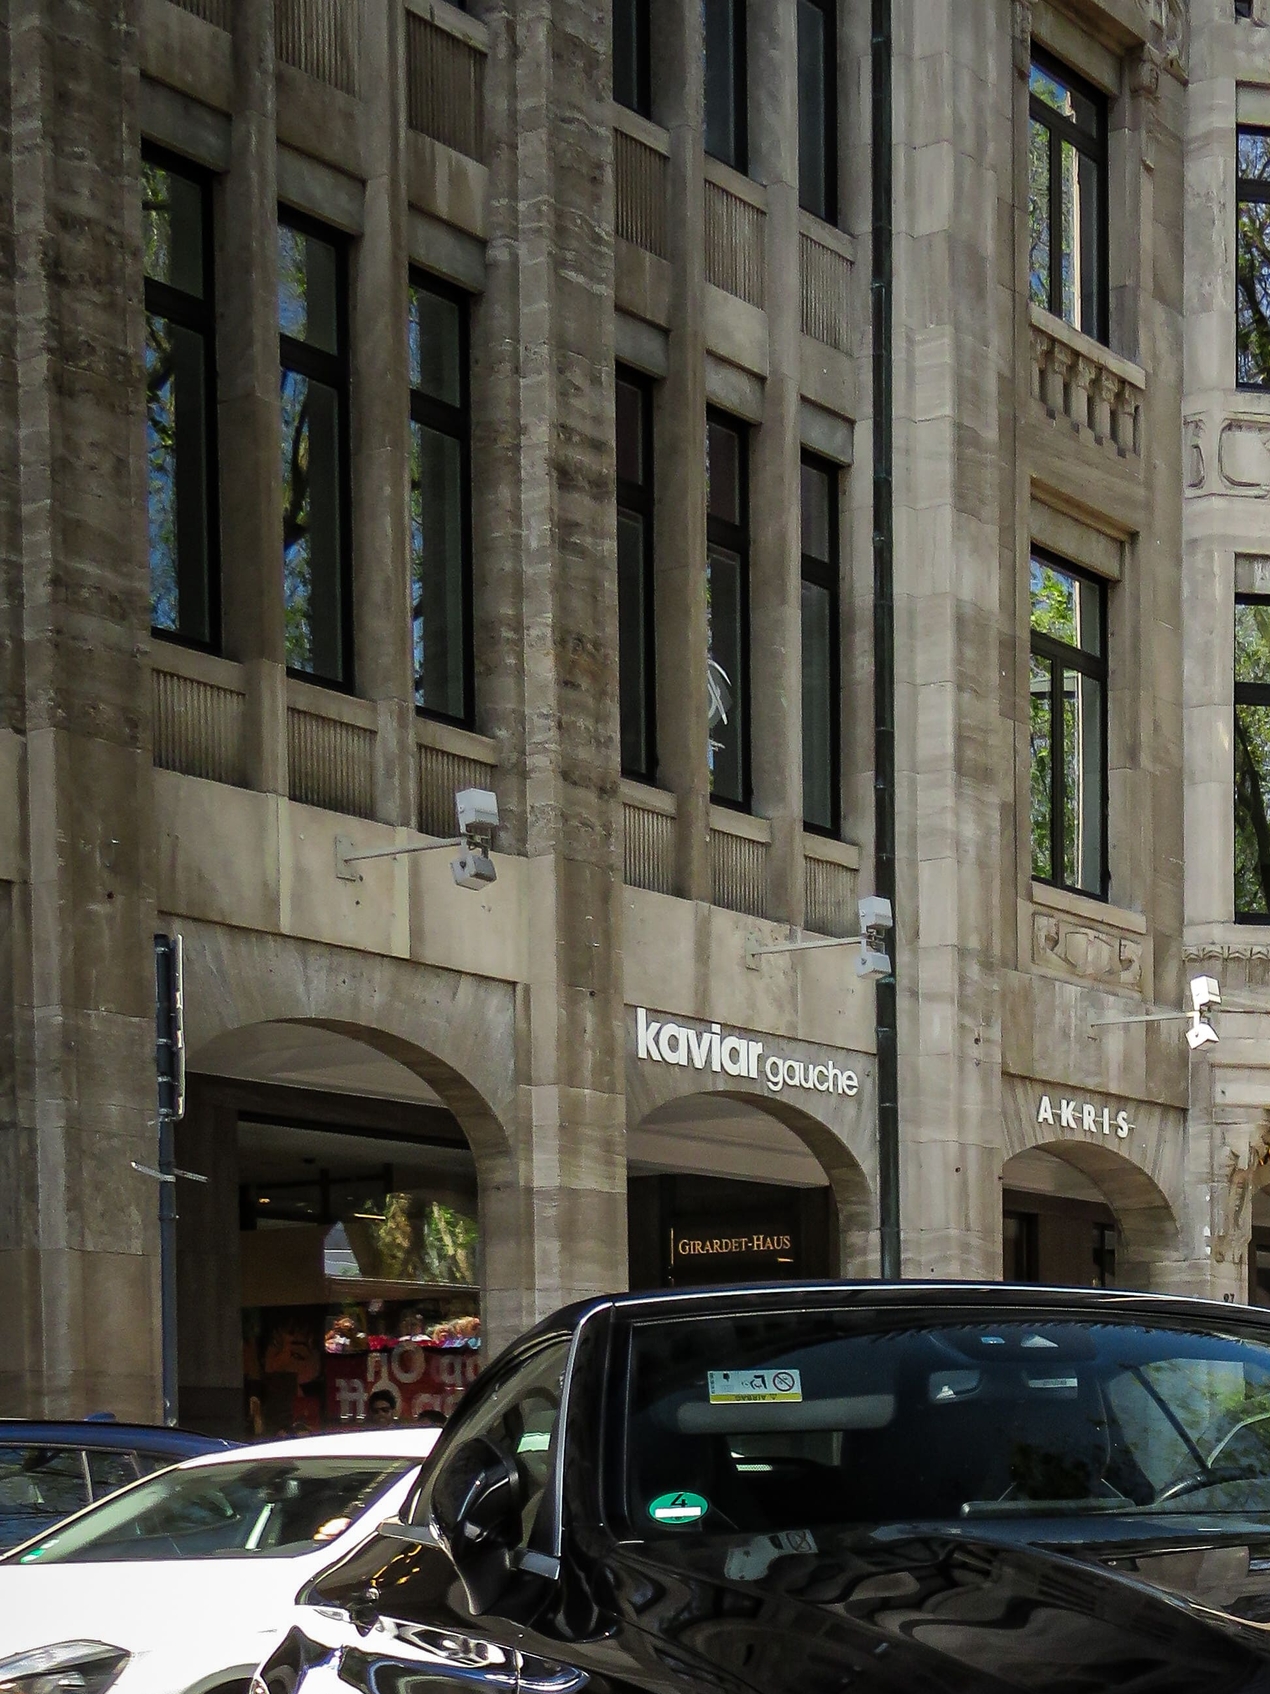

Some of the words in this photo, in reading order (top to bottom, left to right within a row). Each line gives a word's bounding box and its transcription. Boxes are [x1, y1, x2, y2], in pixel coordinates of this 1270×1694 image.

[636, 1007, 763, 1079] kaviar
[765, 1056, 859, 1096] gauche
[1037, 1095, 1129, 1138] AKRIS
[679, 1235, 791, 1255] GIRARDET-HAUS
[670, 1493, 688, 1508] 4
